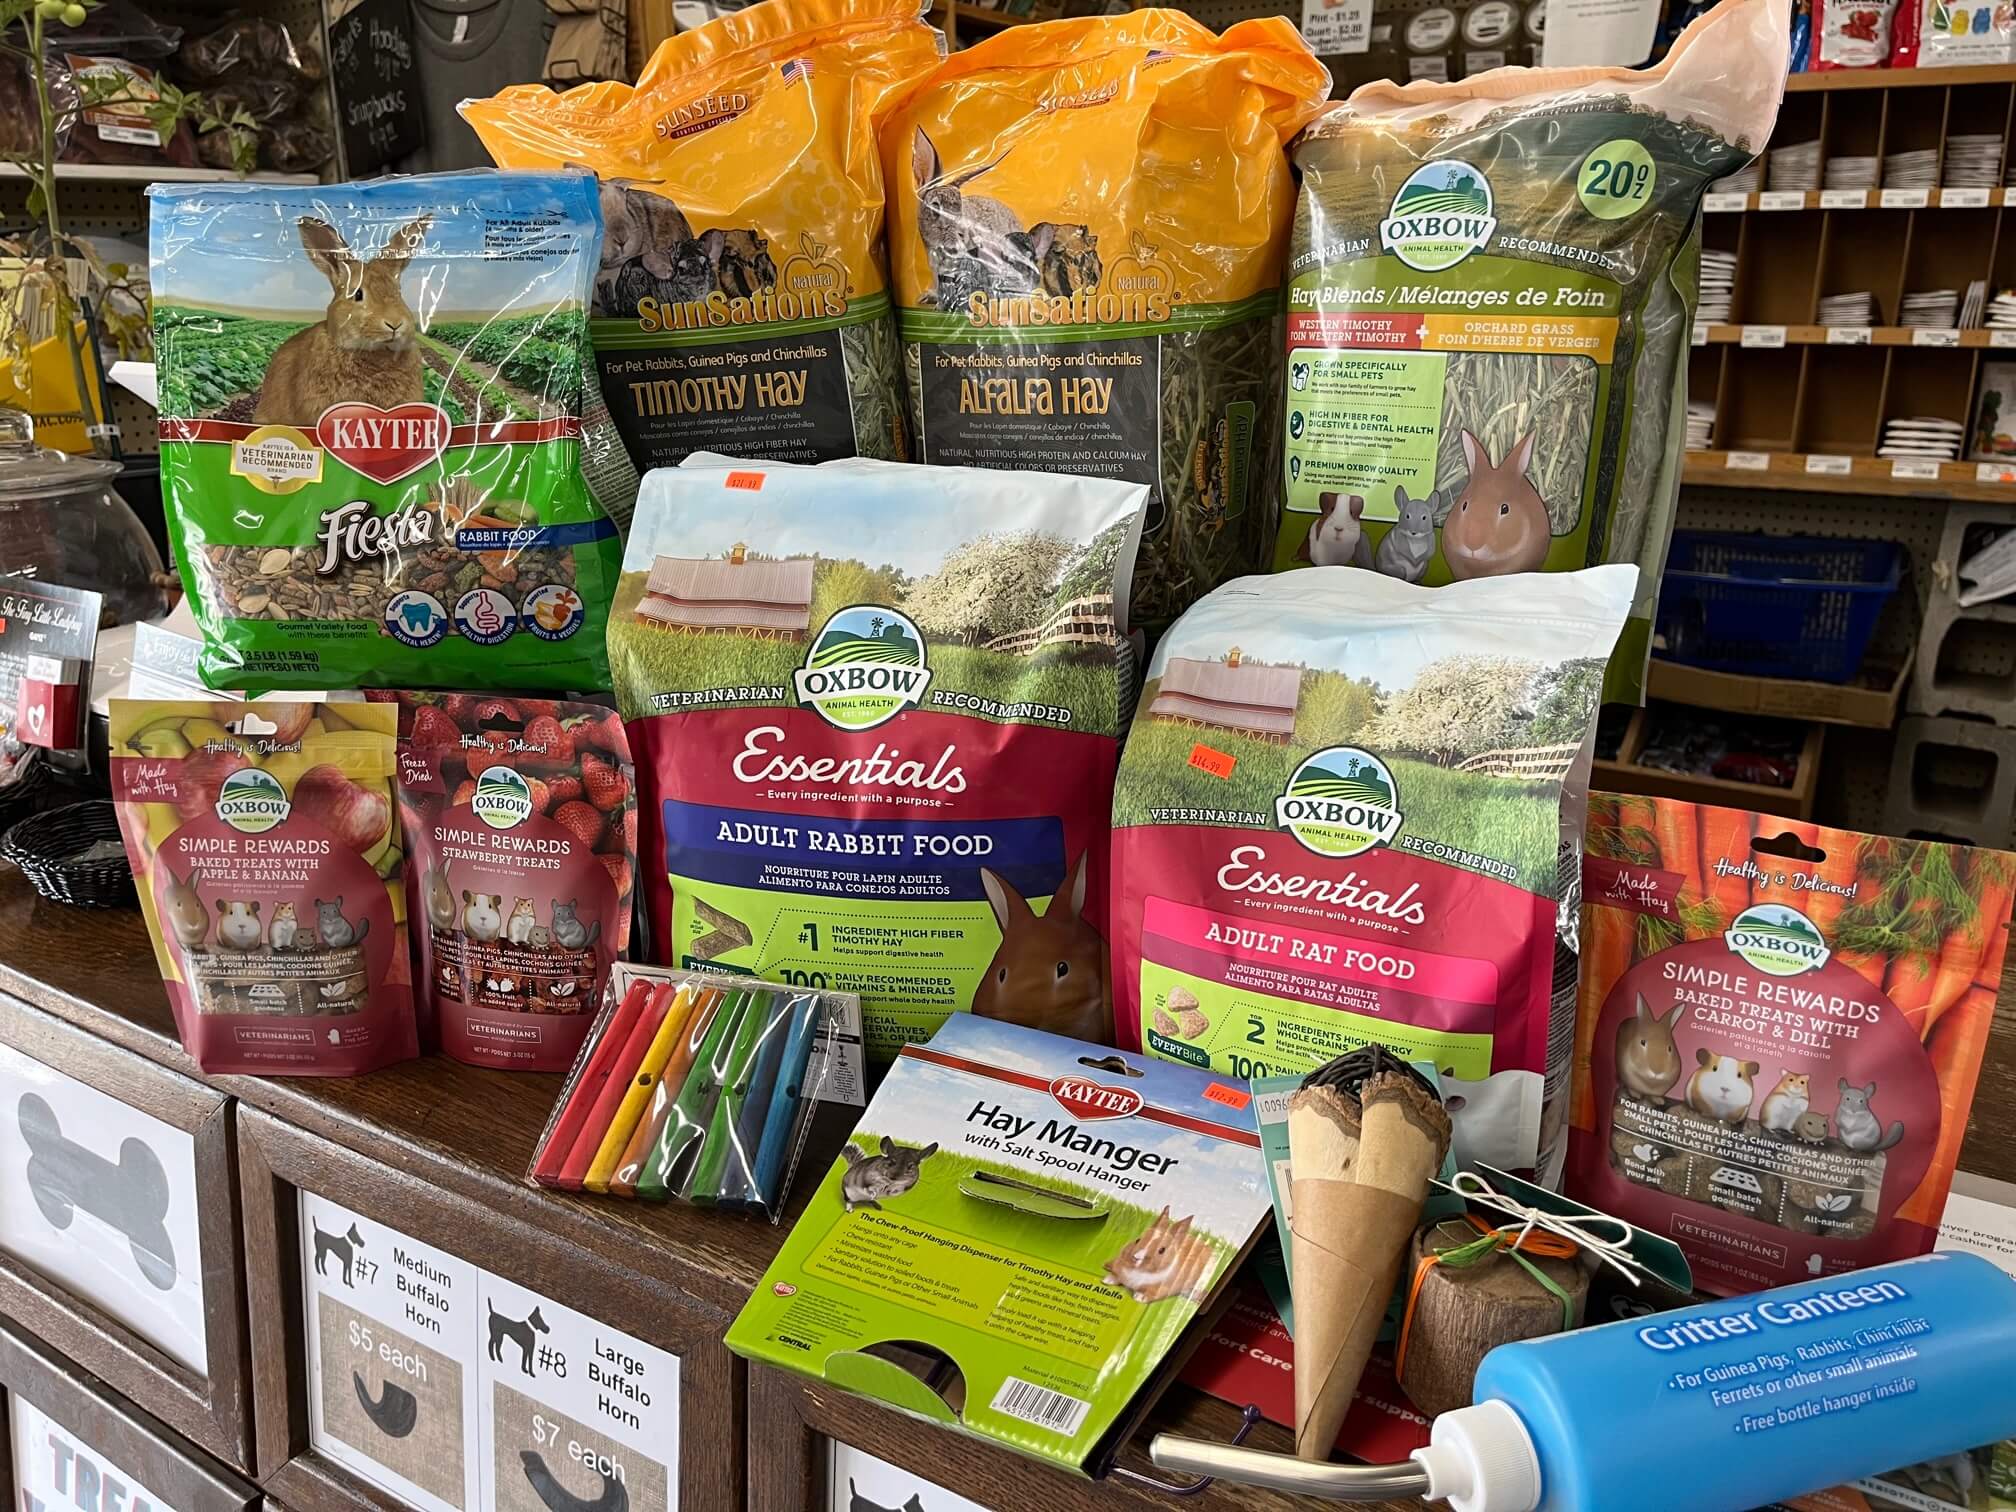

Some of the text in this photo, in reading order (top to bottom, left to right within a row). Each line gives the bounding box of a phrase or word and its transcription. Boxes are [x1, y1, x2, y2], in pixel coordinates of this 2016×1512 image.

[656, 94, 747, 136] SUNSEED
[1584, 159, 1633, 198] 20
[1387, 216, 1488, 240] OXBOW
[1499, 236, 1617, 271] RECOMMENDED
[792, 272, 832, 289] Natural
[1291, 286, 1320, 309] Hay
[1320, 286, 1384, 305] Blends
[1399, 285, 1509, 309] Mélanges
[1515, 288, 1548, 307] de
[1553, 288, 1605, 308] Foin
[638, 284, 848, 332] SunSations
[968, 285, 1172, 328] SunSations
[1312, 369, 1383, 380] FOR SMALL PETS
[331, 417, 438, 450] KAYTEE
[241, 448, 313, 461] VETERINARIAN
[242, 457, 312, 469] RECOMMENDED
[1305, 460, 1418, 477] PREMIUM OXBOW QUALITY
[316, 500, 436, 574] Fiesta
[459, 529, 537, 542] RABBIT FOOD
[277, 623, 313, 632] Gourmet
[314, 623, 345, 632] Variety
[650, 686, 785, 711] VETERINARIAN
[804, 668, 922, 696] OXBOW
[825, 699, 894, 710] ANIMAL HEALTH
[933, 691, 1072, 724] RECOMMENDED
[732, 725, 967, 794] Essentials
[220, 801, 286, 815] OXBOW
[475, 797, 529, 815] OXBOW
[1149, 808, 1267, 826] VETERINARIAN
[1283, 799, 1395, 834] OXBOW
[179, 838, 330, 855] SIMPLE REWARDS
[434, 827, 571, 855] SIMPLE REWARDS
[716, 821, 993, 857] ADULT RABBIT FOOD
[190, 857, 319, 869] BAKED TREATS WITH
[201, 868, 309, 881] APPLE & BANANA
[442, 847, 561, 870] STRAWBERRY TREATS
[765, 864, 942, 884] NOURRITURE POUR LAPIN ADULTE
[1402, 835, 1518, 881] RECOMMENDED
[758, 874, 950, 896] ALIMENTO PARA CONEJOS ADULTOS
[1216, 845, 1426, 926] Essentials
[1712, 857, 1858, 900] Healthy is Delicious!
[797, 922, 819, 952] #1
[831, 925, 964, 939] INGREDIENT HIGH FIBER
[832, 935, 903, 947] TIMOTHY HAY
[1731, 933, 1822, 961] OXBOW
[1204, 922, 1416, 981] ADULT RAT FOOD
[1228, 962, 1379, 1001] NOURRITURE POUR RAT ADULTE
[1663, 961, 1881, 1024] SIMPLE REWARDS
[1673, 988, 1859, 1040] BAKED TREATS WITH
[1694, 1007, 1831, 1050] CARROT & DILL
[240, 1030, 311, 1041] VETERINARIANS
[470, 1023, 537, 1039] VETERINARIANS
[1056, 1081, 1136, 1115] KAYTEE
[965, 1101, 1179, 1177] Hay Manger
[964, 1131, 1151, 1194] with Salt Spool Hanger
[860, 1212, 1124, 1301] The Chew-Proof Hanging Dispenser for Timothy Hay and Alfalfa
[1677, 1221, 1781, 1261] VETERINARIANS
[1949, 1234, 2014, 1254] cashier for
[355, 1256, 380, 1285] #7
[393, 1247, 452, 1289] Medium
[396, 1274, 450, 1313] Buffalo
[405, 1302, 441, 1335] Horn
[1638, 1278, 1907, 1352] Critter Canteen
[349, 1319, 427, 1383] $5 each
[595, 1337, 645, 1377] Large
[778, 1334, 812, 1352] CENTRAL
[1675, 1317, 1931, 1391] For Guinea Pigs, Rabbits, Chinchillas
[538, 1344, 568, 1379] #8
[1249, 1349, 1293, 1371] Care
[1711, 1344, 1918, 1408] Ferrets or other small animals
[588, 1363, 651, 1407] Buffalo
[598, 1393, 641, 1430] Horn
[1742, 1375, 1917, 1433] Free bottle hanger inside
[531, 1413, 626, 1484] $7 each
